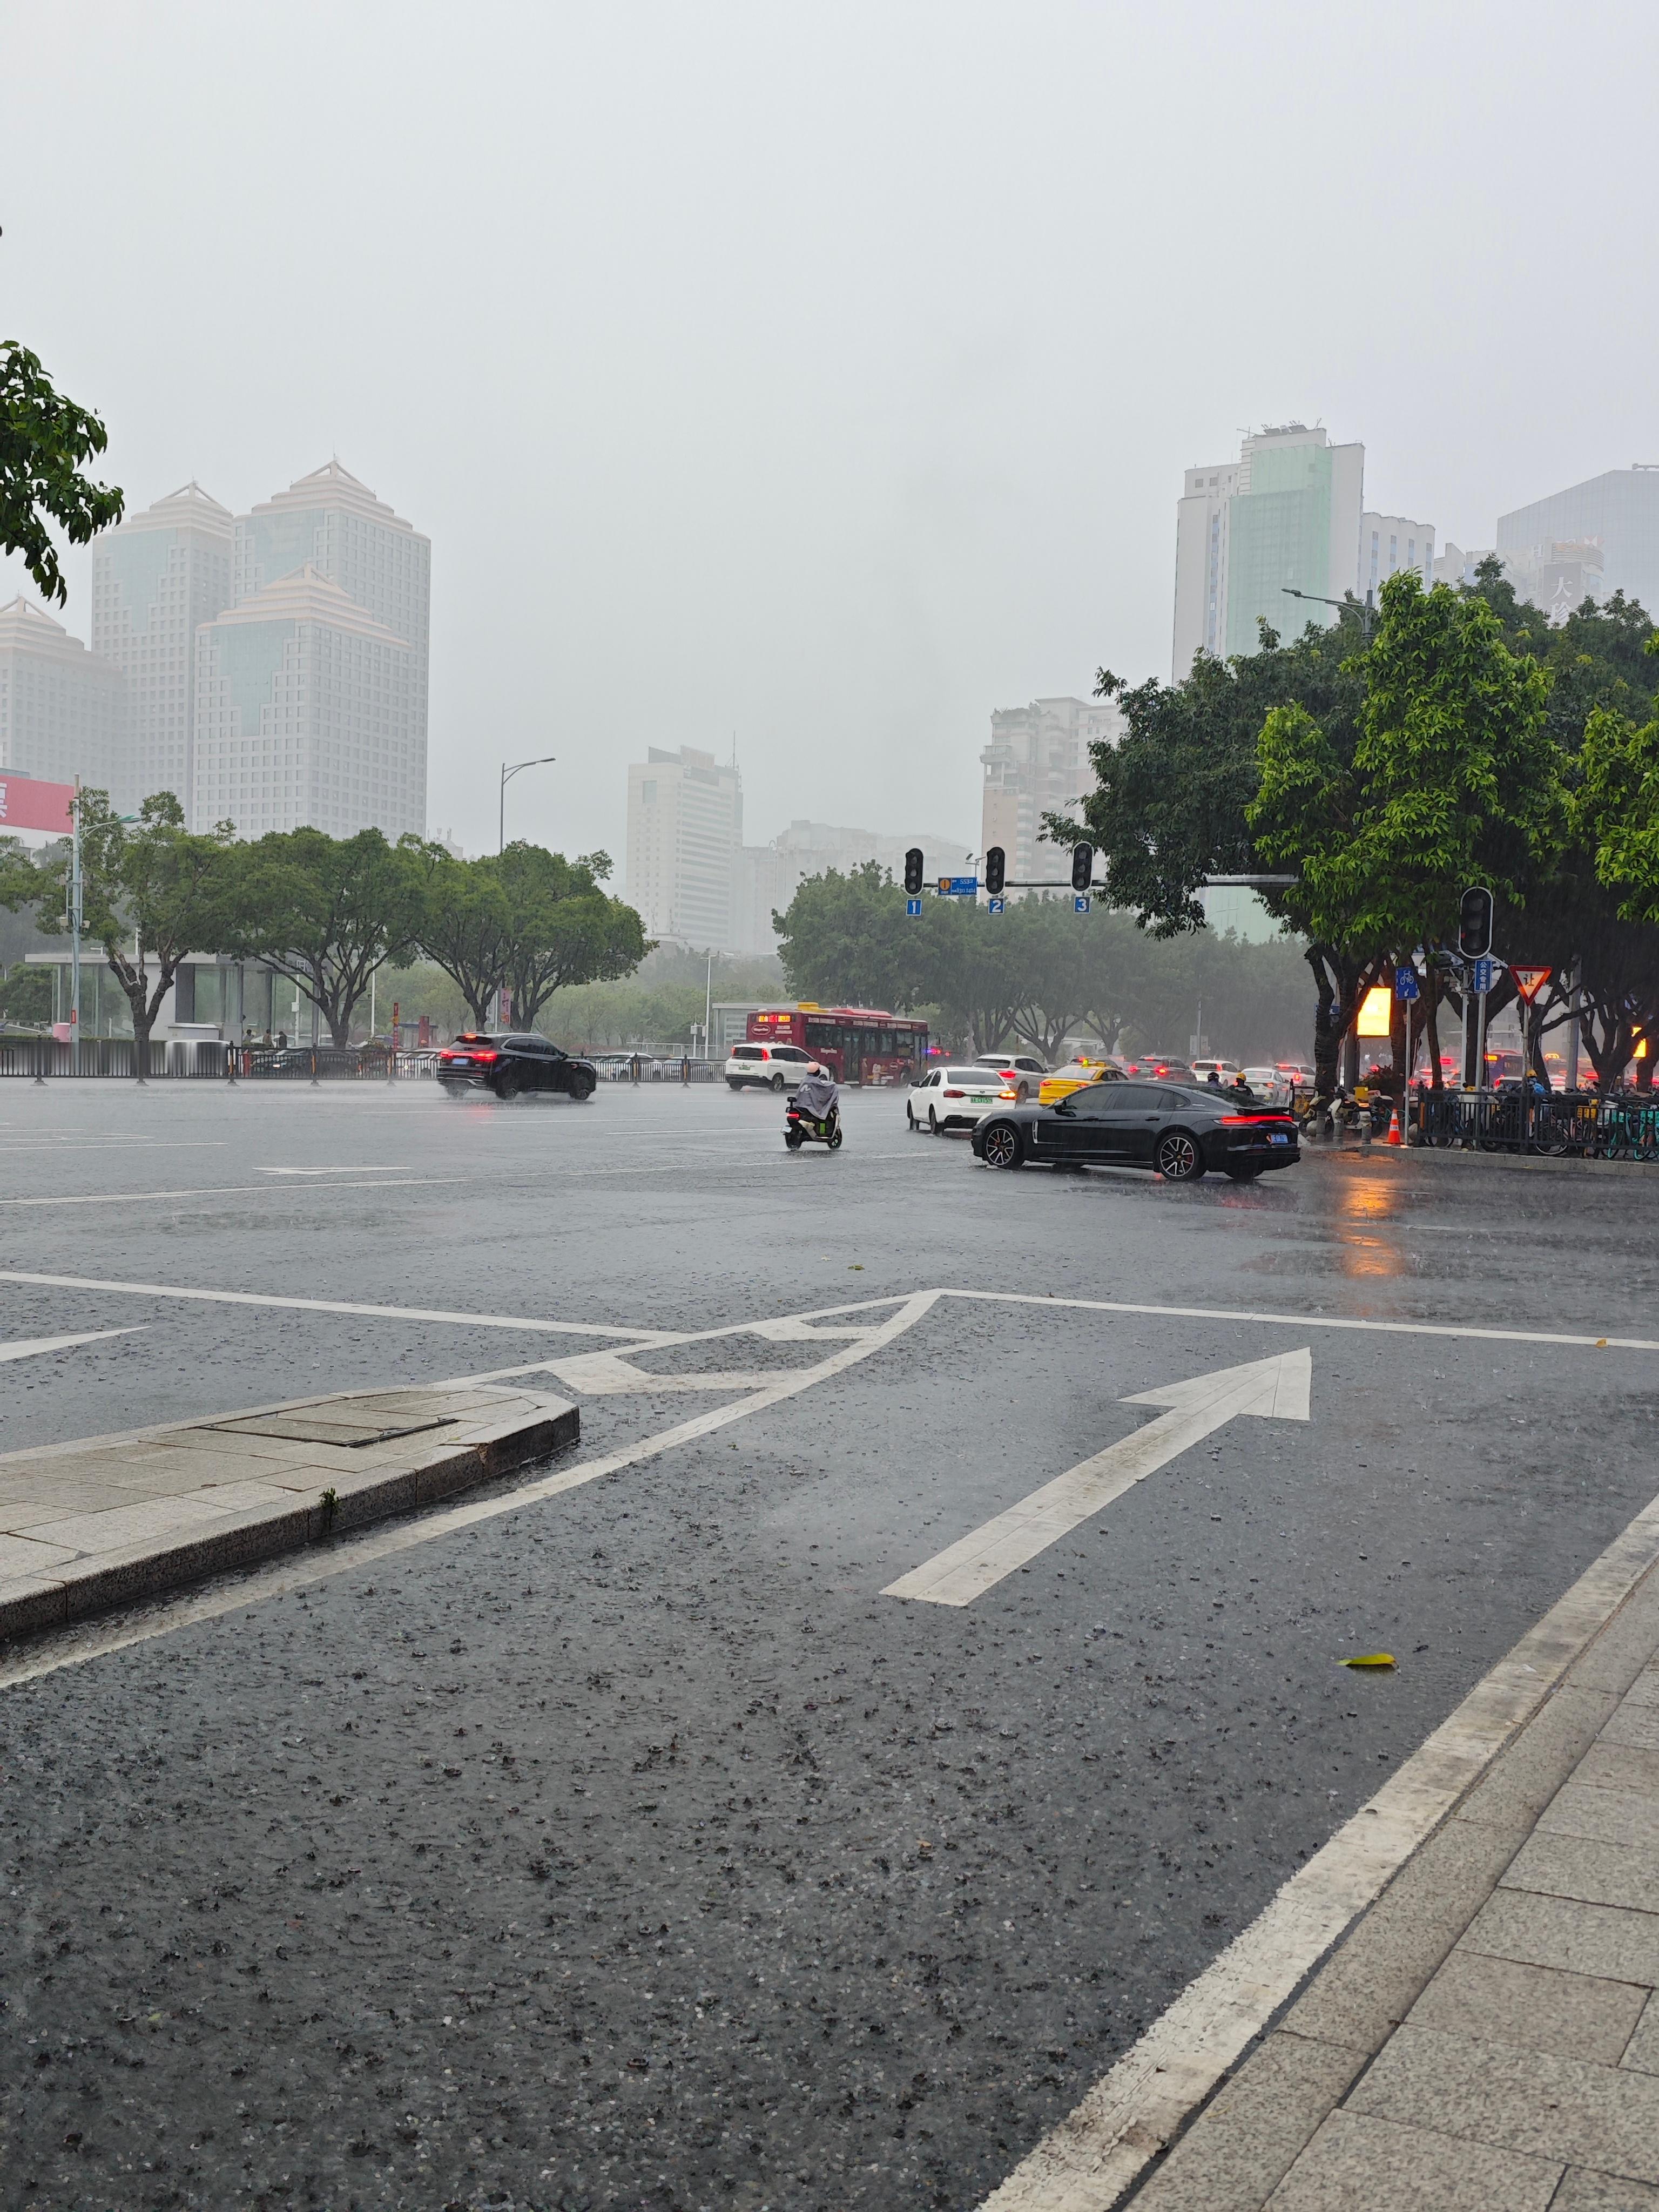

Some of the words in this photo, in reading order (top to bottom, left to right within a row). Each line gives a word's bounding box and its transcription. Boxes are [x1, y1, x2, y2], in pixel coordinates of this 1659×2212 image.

[912, 901, 916, 914] 1
[992, 899, 1001, 913] 2
[1077, 899, 1087, 911] 3
[1479, 962, 1487, 990] 公交专用
[1523, 973, 1535, 986] 让
